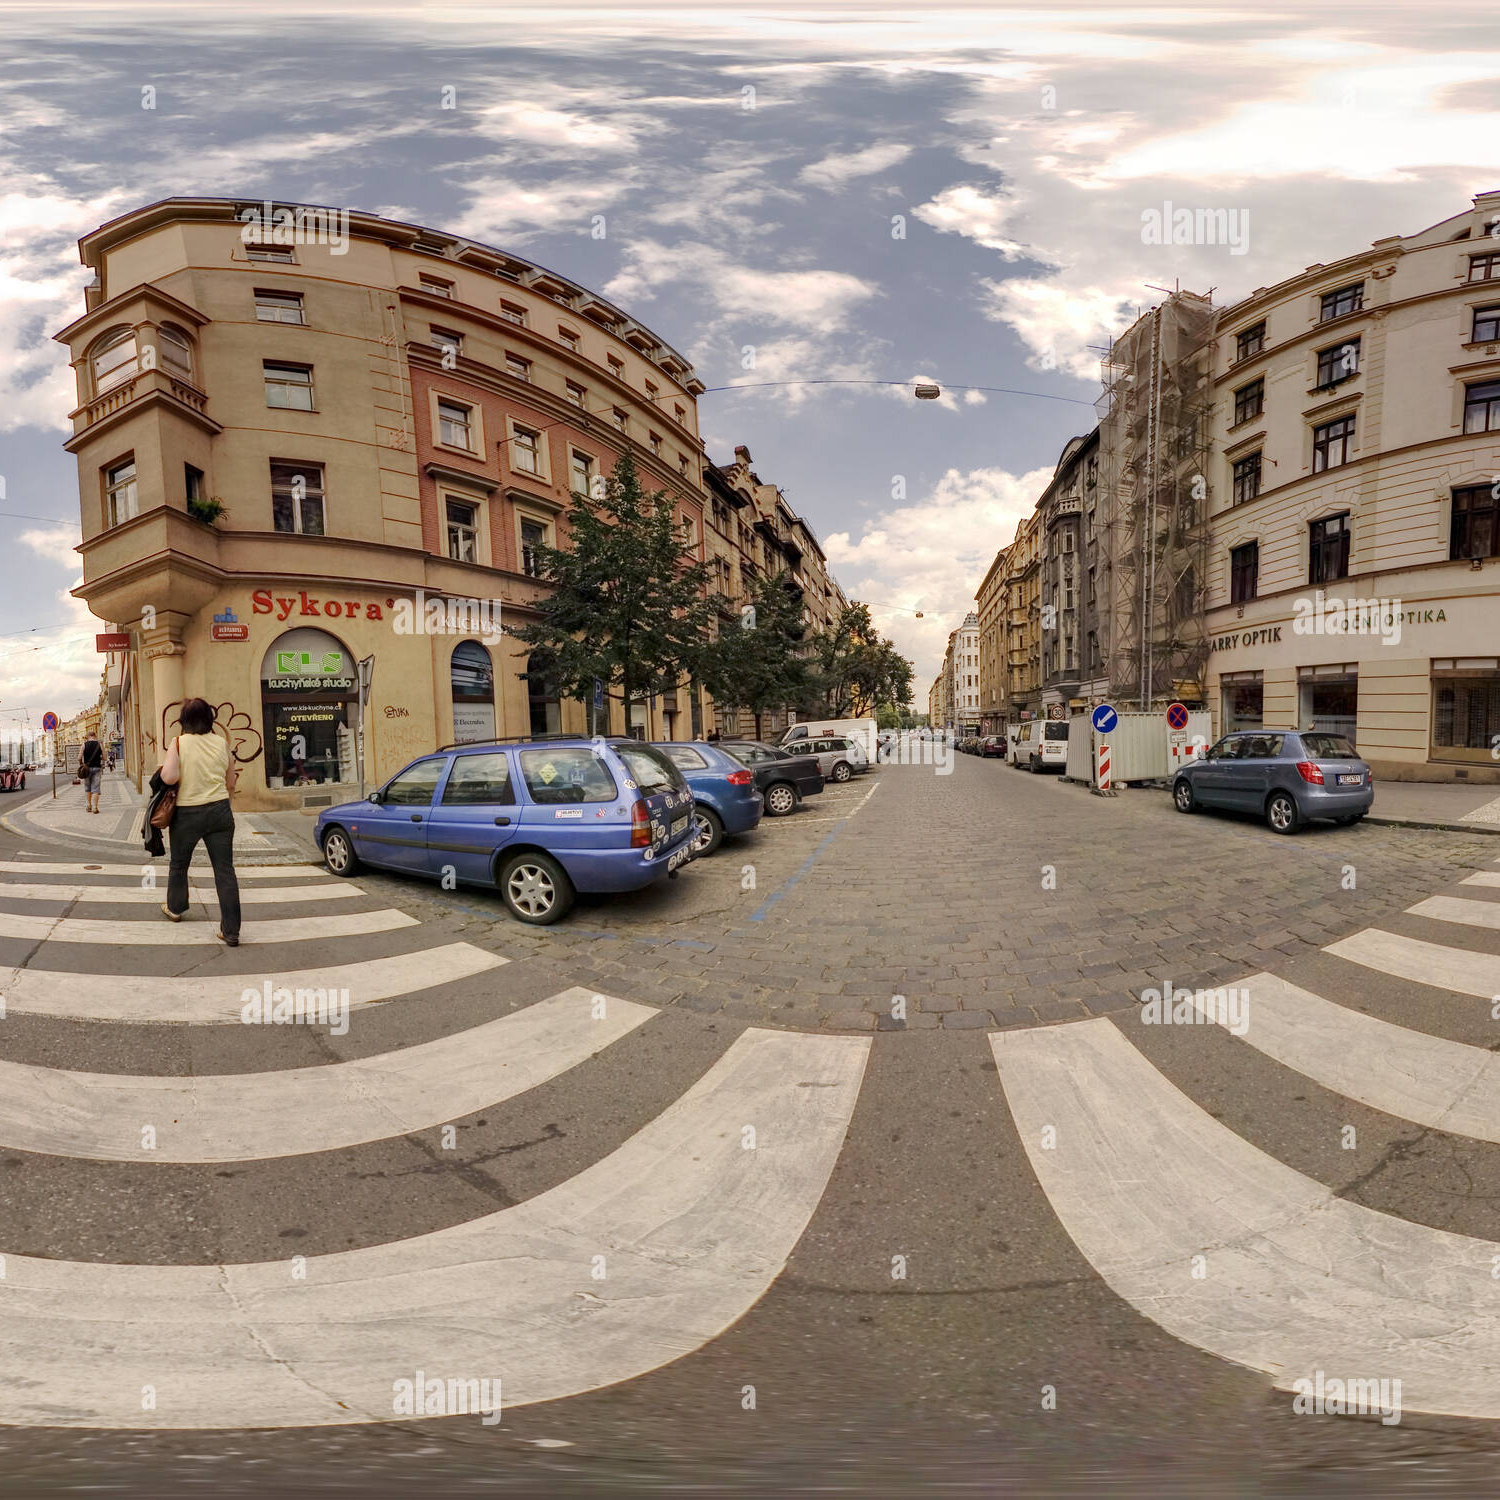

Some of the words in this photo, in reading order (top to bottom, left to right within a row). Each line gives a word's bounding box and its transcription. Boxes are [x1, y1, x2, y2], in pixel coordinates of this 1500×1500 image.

[252, 589, 383, 620] Sykora
[1384, 609, 1447, 628] OPTIKA
[1208, 634, 1239, 653] ARRY
[1242, 627, 1282, 646] OPTIK
[276, 651, 343, 674] KLS
[268, 676, 321, 689] kuchyňské
[322, 677, 351, 688] studio
[595, 681, 603, 693] P
[290, 712, 334, 721] OTEVŘENO
[1054, 708, 1062, 716] 30
[276, 725, 300, 733] Po-Pá
